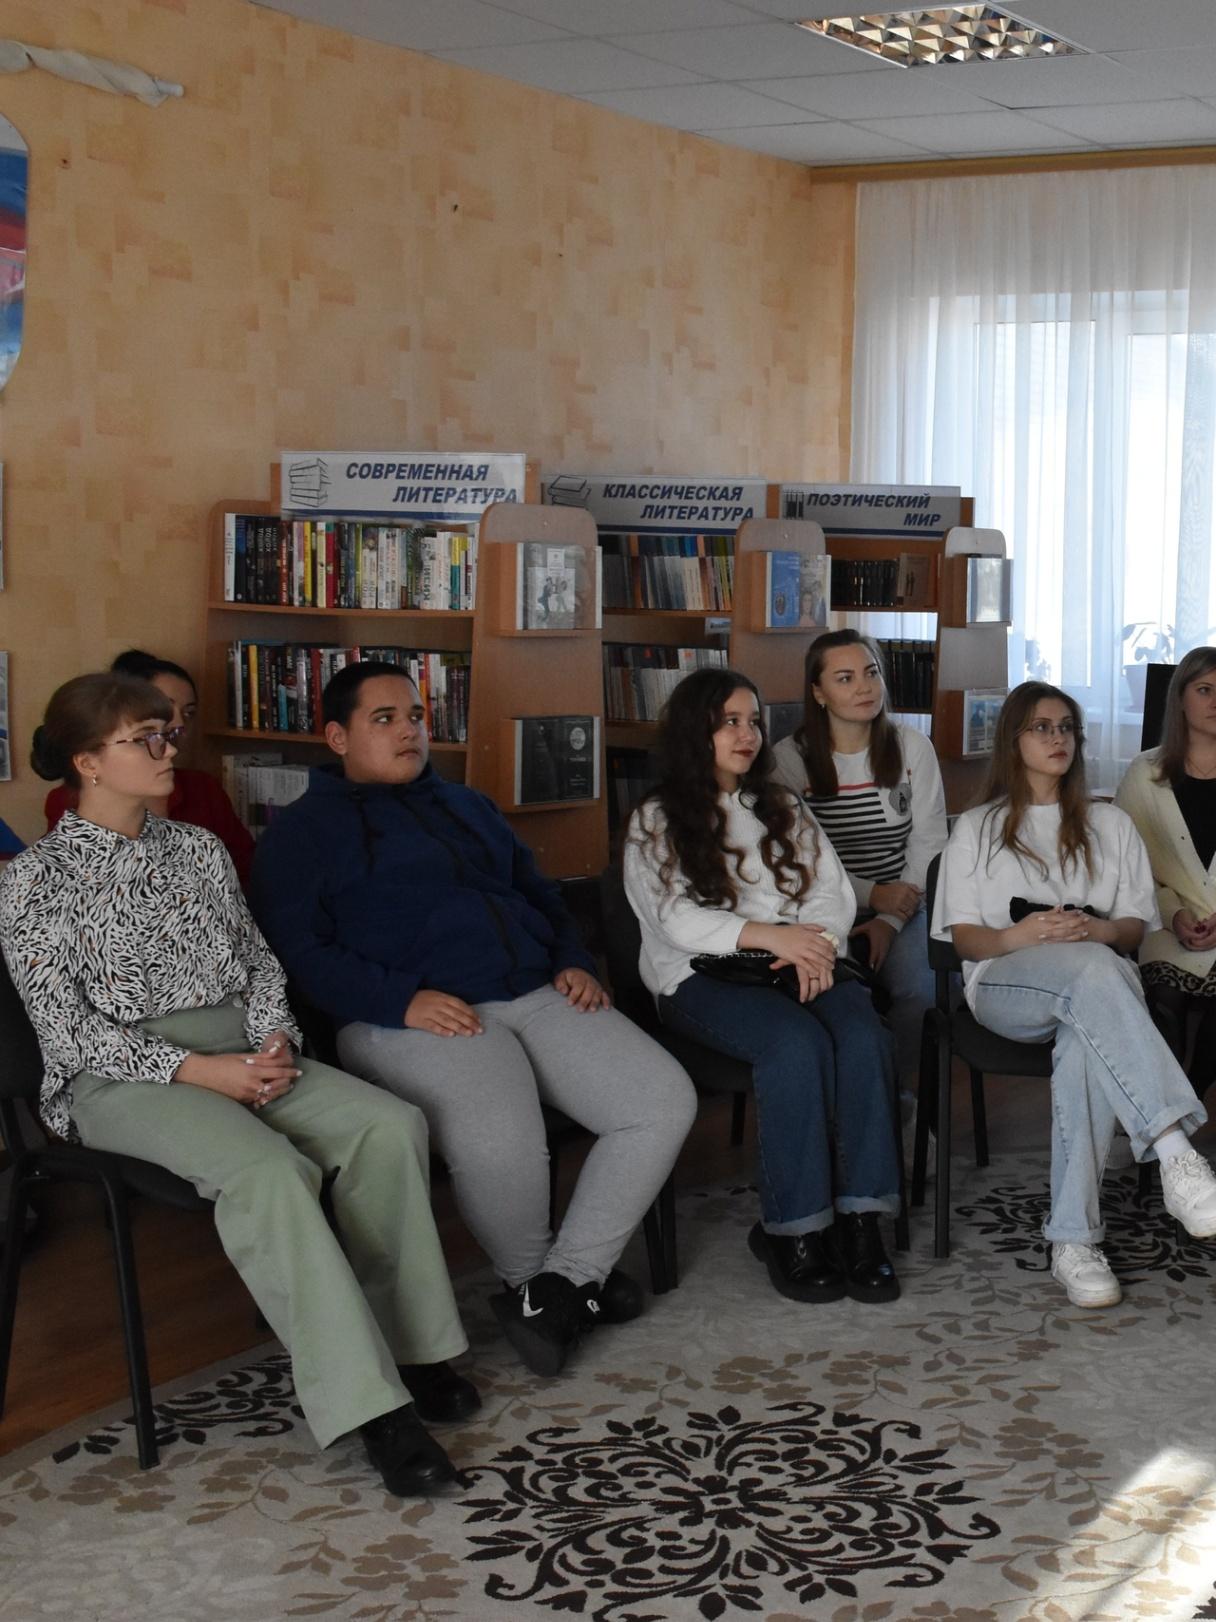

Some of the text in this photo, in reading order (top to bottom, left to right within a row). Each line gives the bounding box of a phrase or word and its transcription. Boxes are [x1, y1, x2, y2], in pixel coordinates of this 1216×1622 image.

[345, 462, 490, 482] СОВРЕМЕННАЯ
[392, 486, 519, 505] ЛИТЕРАТУРА
[602, 483, 744, 502] КЛАССИЧЕСКАЯ
[806, 490, 932, 509] ПОЭТИЧЕСКИЙ
[639, 505, 755, 523] ЛИТЕРАТУРА
[903, 512, 942, 527] МИР
